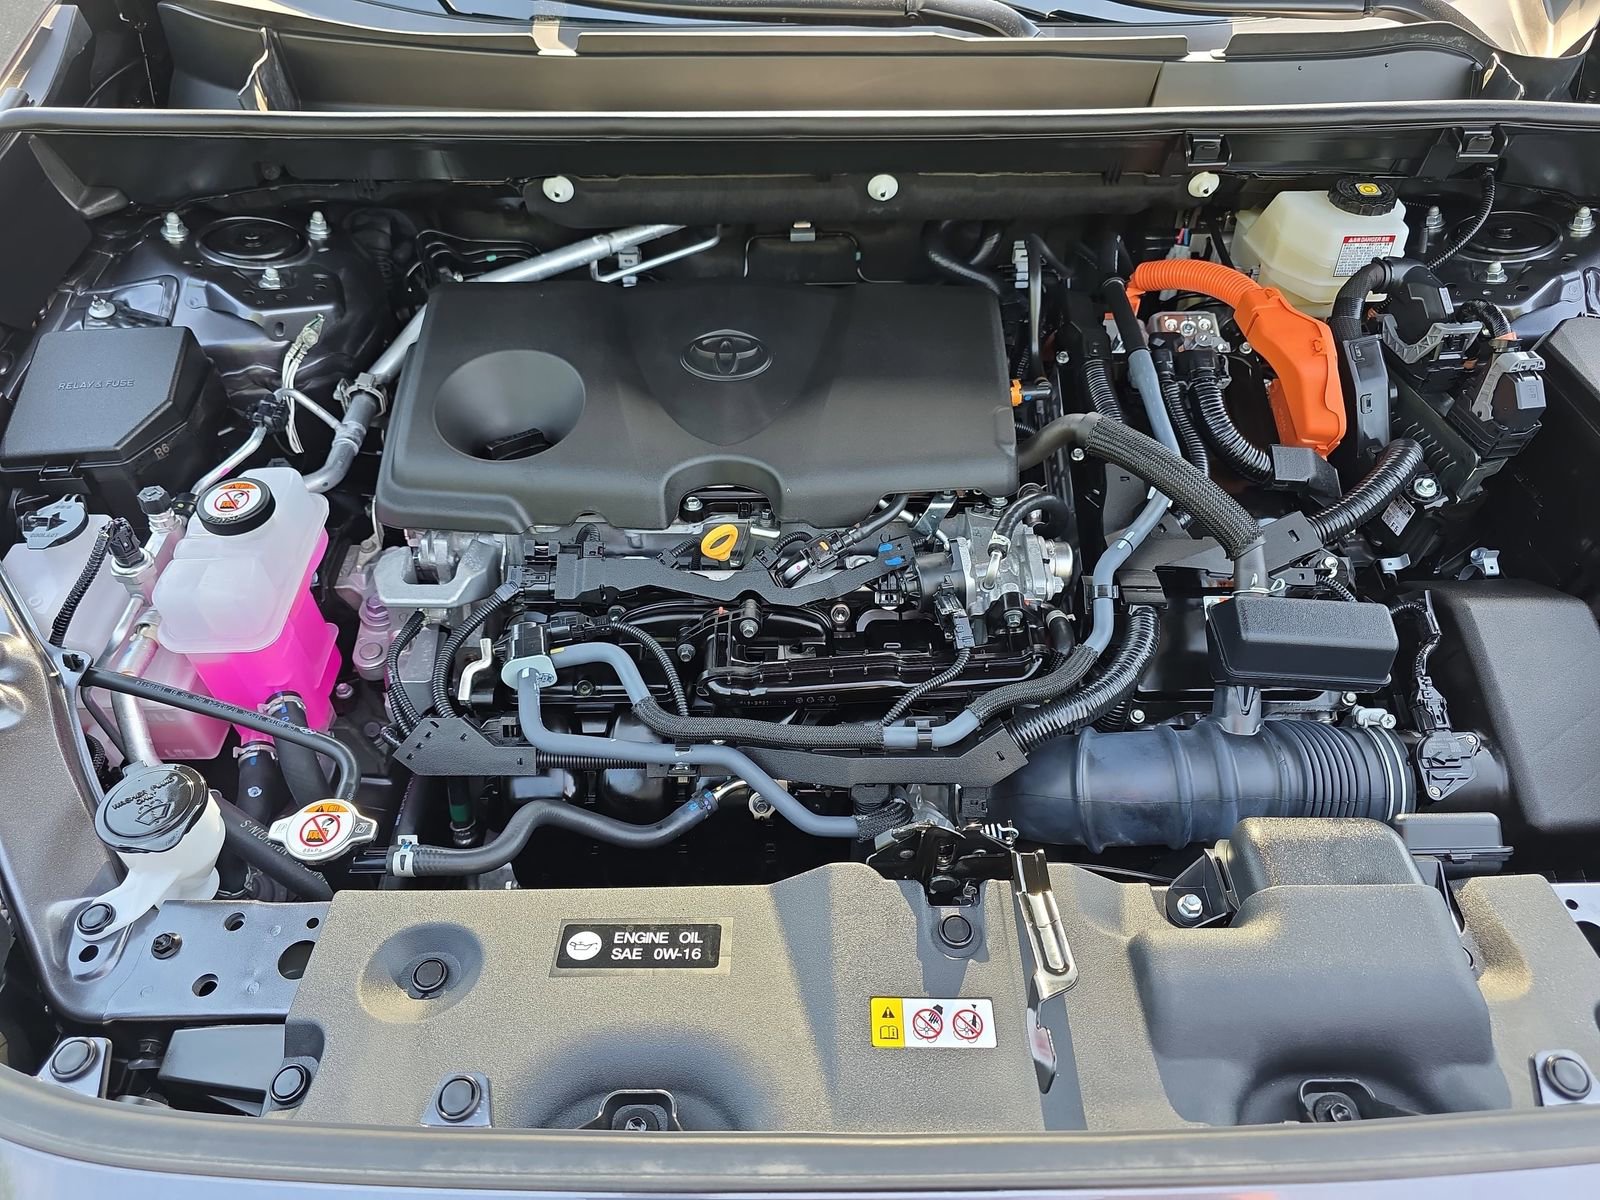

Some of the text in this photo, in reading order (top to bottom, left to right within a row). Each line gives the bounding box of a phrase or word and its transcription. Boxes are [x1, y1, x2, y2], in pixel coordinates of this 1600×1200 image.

[1360, 235, 1382, 243] DANGER
[57, 381, 95, 391] RELAY
[105, 379, 136, 388] FUSE
[153, 442, 170, 460] R6
[112, 777, 175, 810] WASHER FLUID
[613, 931, 704, 944] ENGINE OIL
[611, 948, 702, 960] SAE 0W-16
